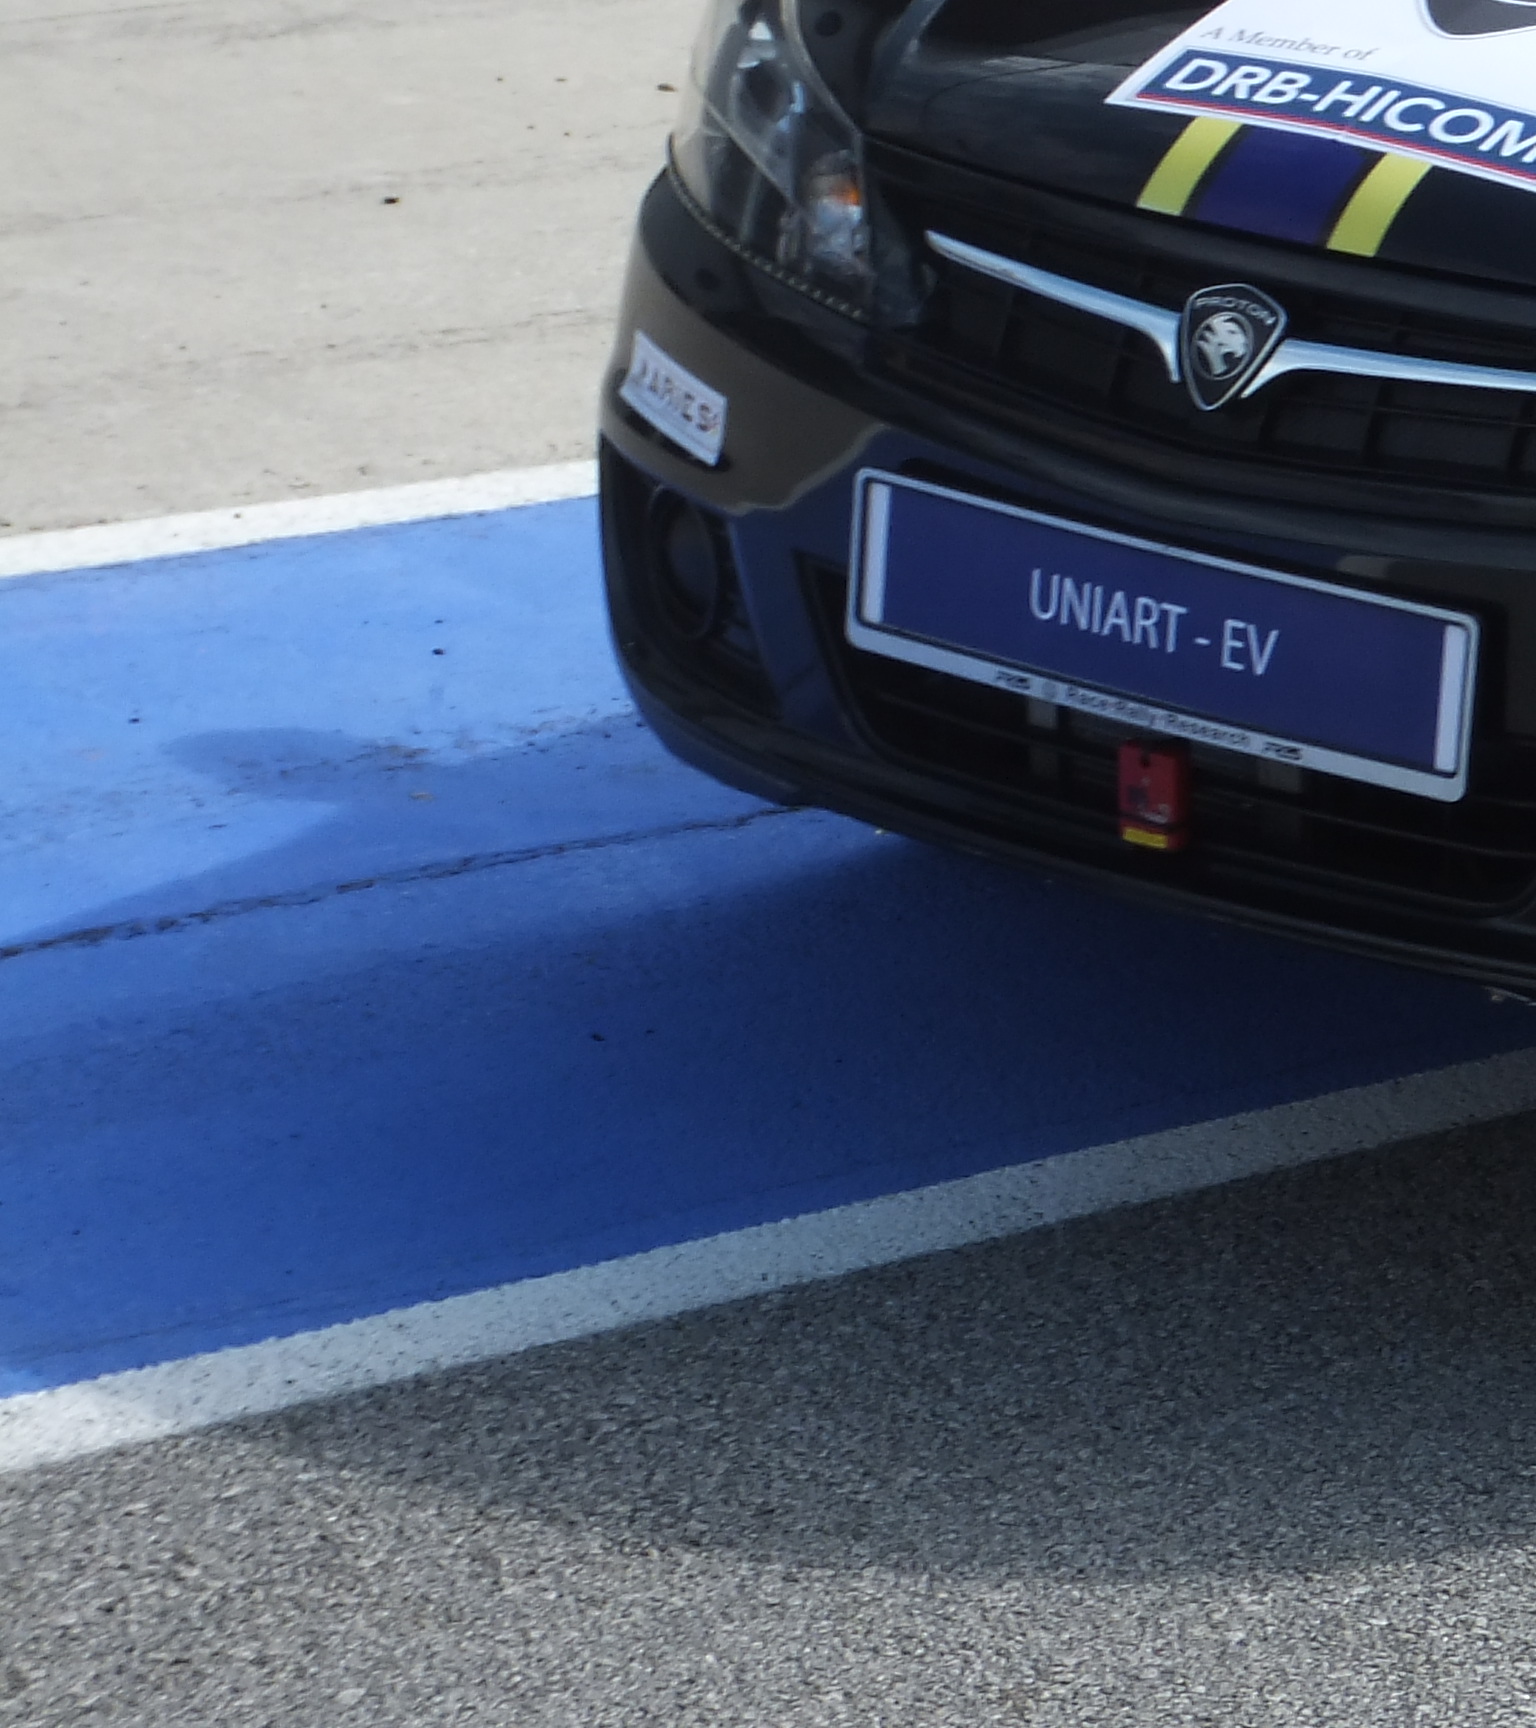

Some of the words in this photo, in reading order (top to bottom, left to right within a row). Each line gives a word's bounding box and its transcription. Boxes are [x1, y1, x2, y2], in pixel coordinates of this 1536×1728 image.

[1228, 27, 1333, 58] Member
[1344, 44, 1379, 63] of
[1194, 293, 1279, 326] PROTON
[1031, 569, 1187, 653] UNIART
[1222, 618, 1280, 675] EV
